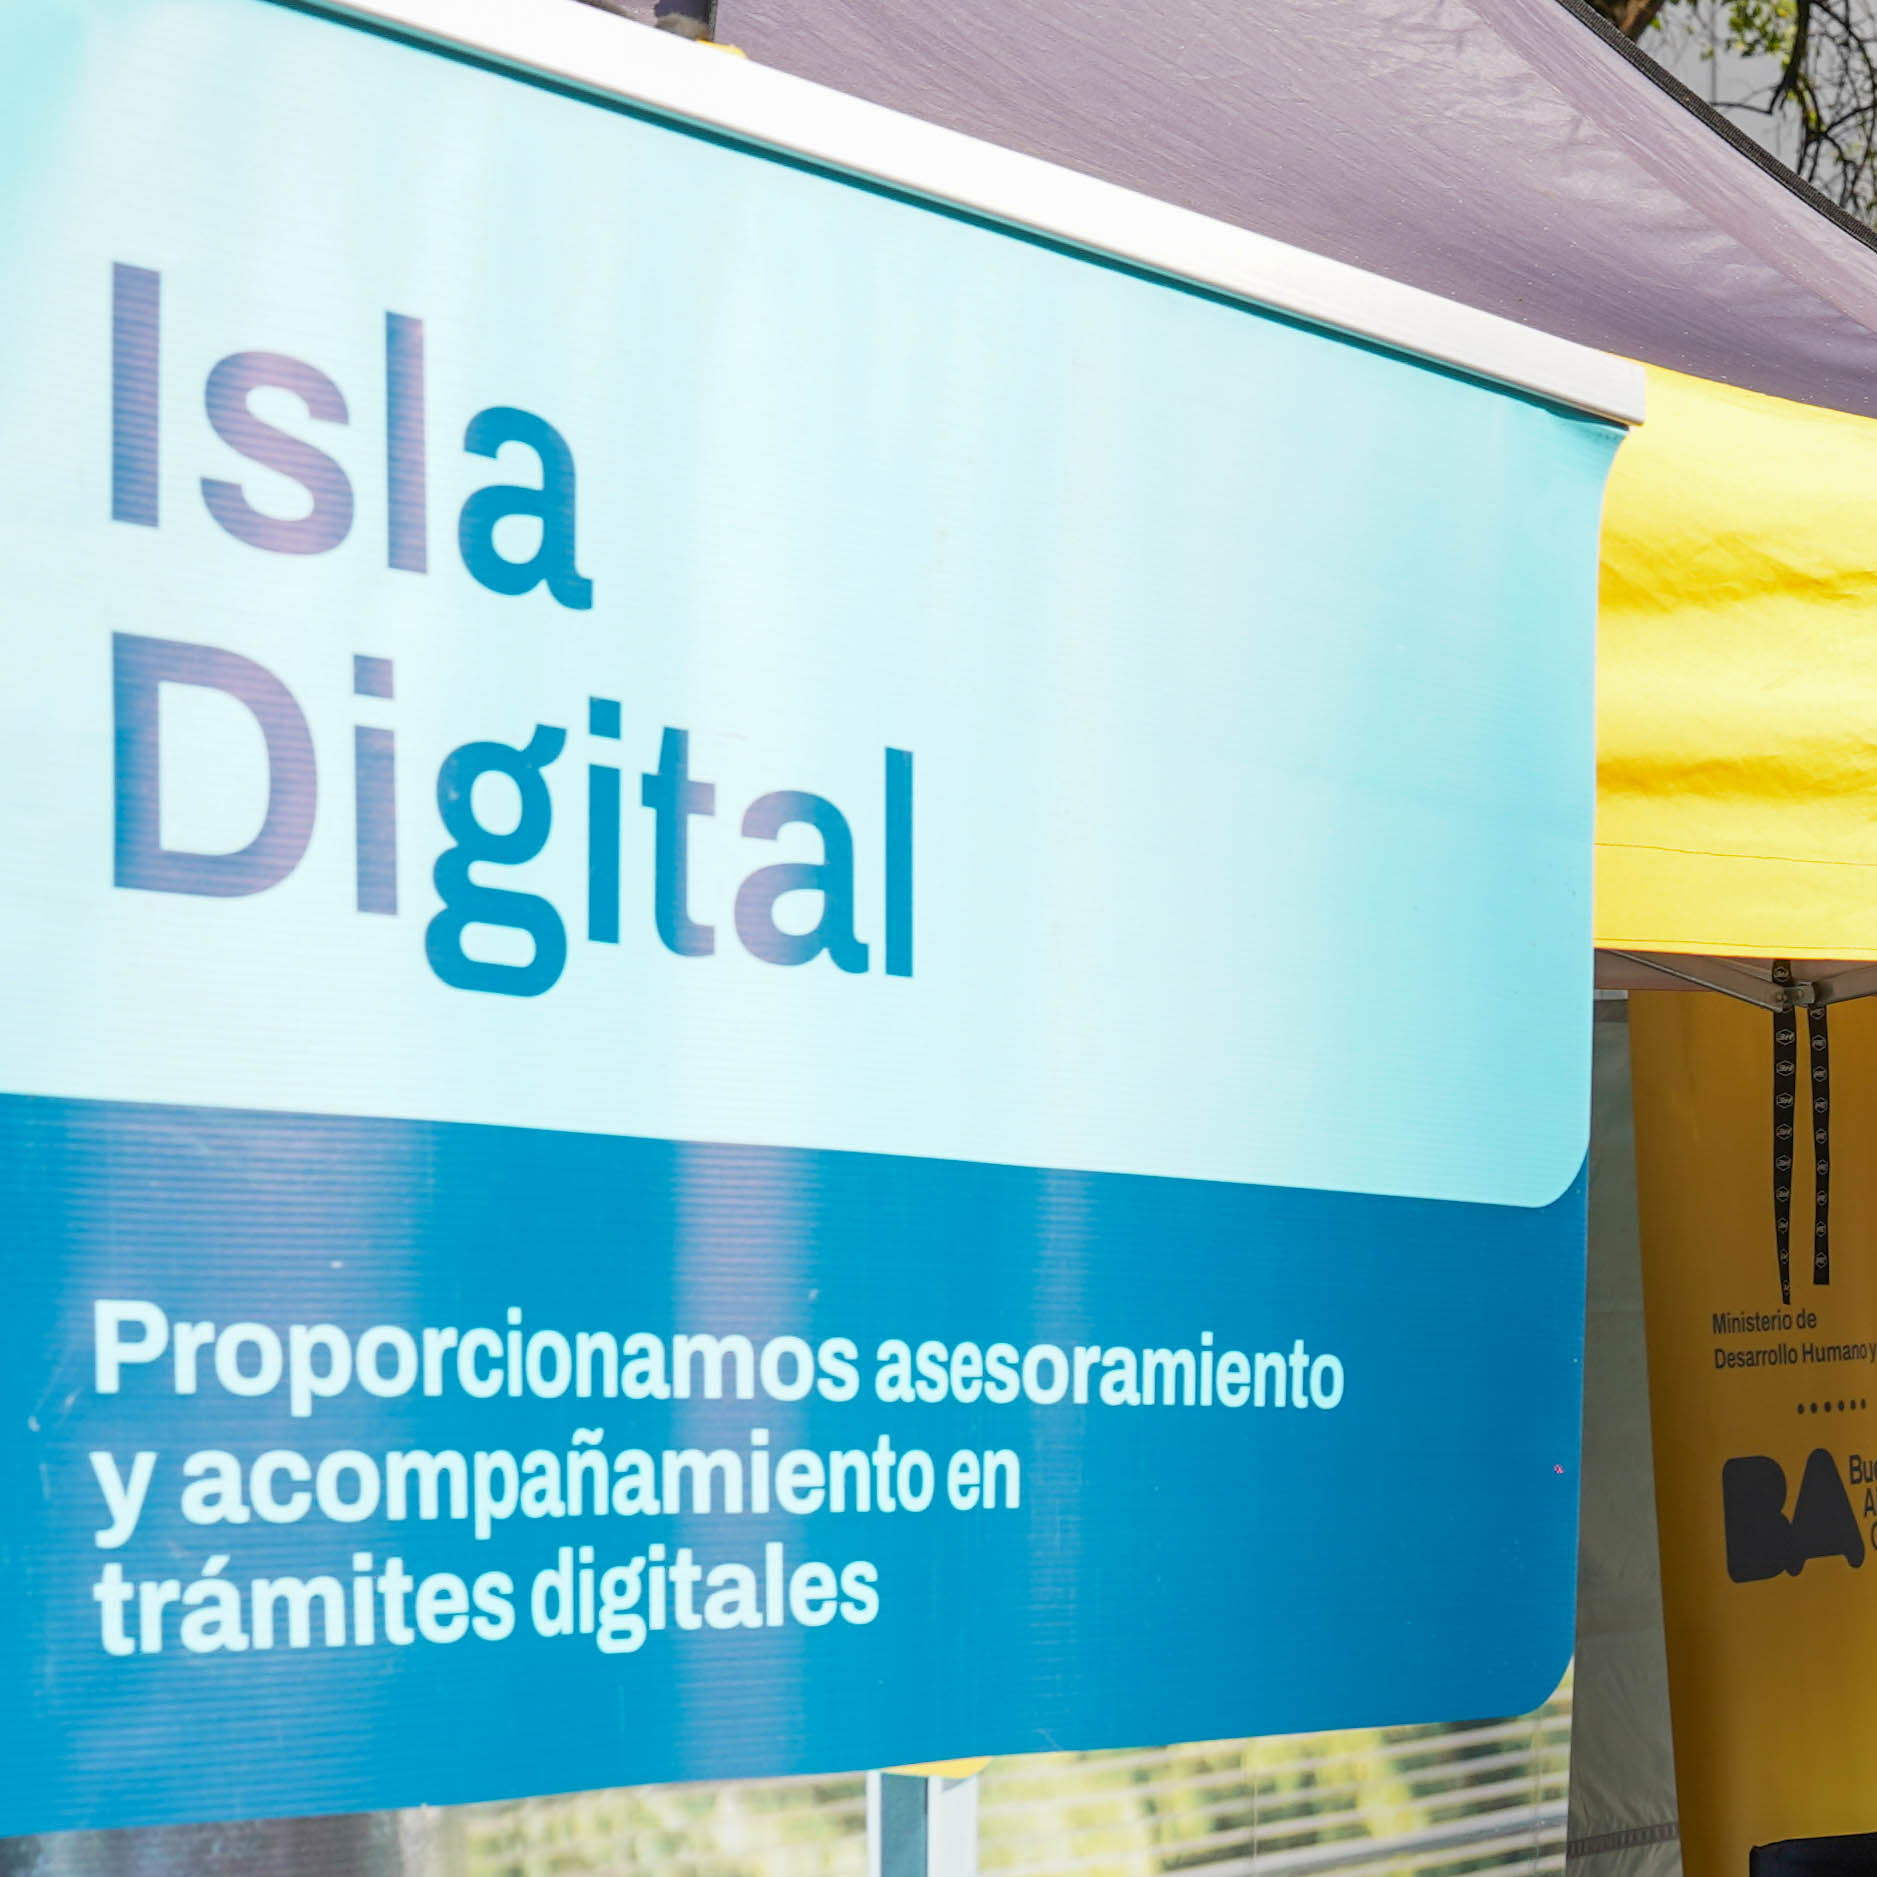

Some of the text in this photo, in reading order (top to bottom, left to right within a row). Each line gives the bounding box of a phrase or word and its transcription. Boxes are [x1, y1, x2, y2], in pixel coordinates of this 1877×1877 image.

[111, 261, 593, 611] Isla
[111, 630, 914, 997] Digital
[93, 1299, 1345, 1415] Proporcionamos asesoramiento
[1712, 1308, 1817, 1335] Ministerio de
[1714, 1343, 1799, 1370] Desarrollo
[1802, 1340, 1867, 1365] Humano
[1868, 1343, 1877, 1364] y
[90, 1428, 1020, 1548] y acompañamiento en
[1721, 1448, 1865, 1583] BA
[95, 1542, 880, 1657] trámites digitales
